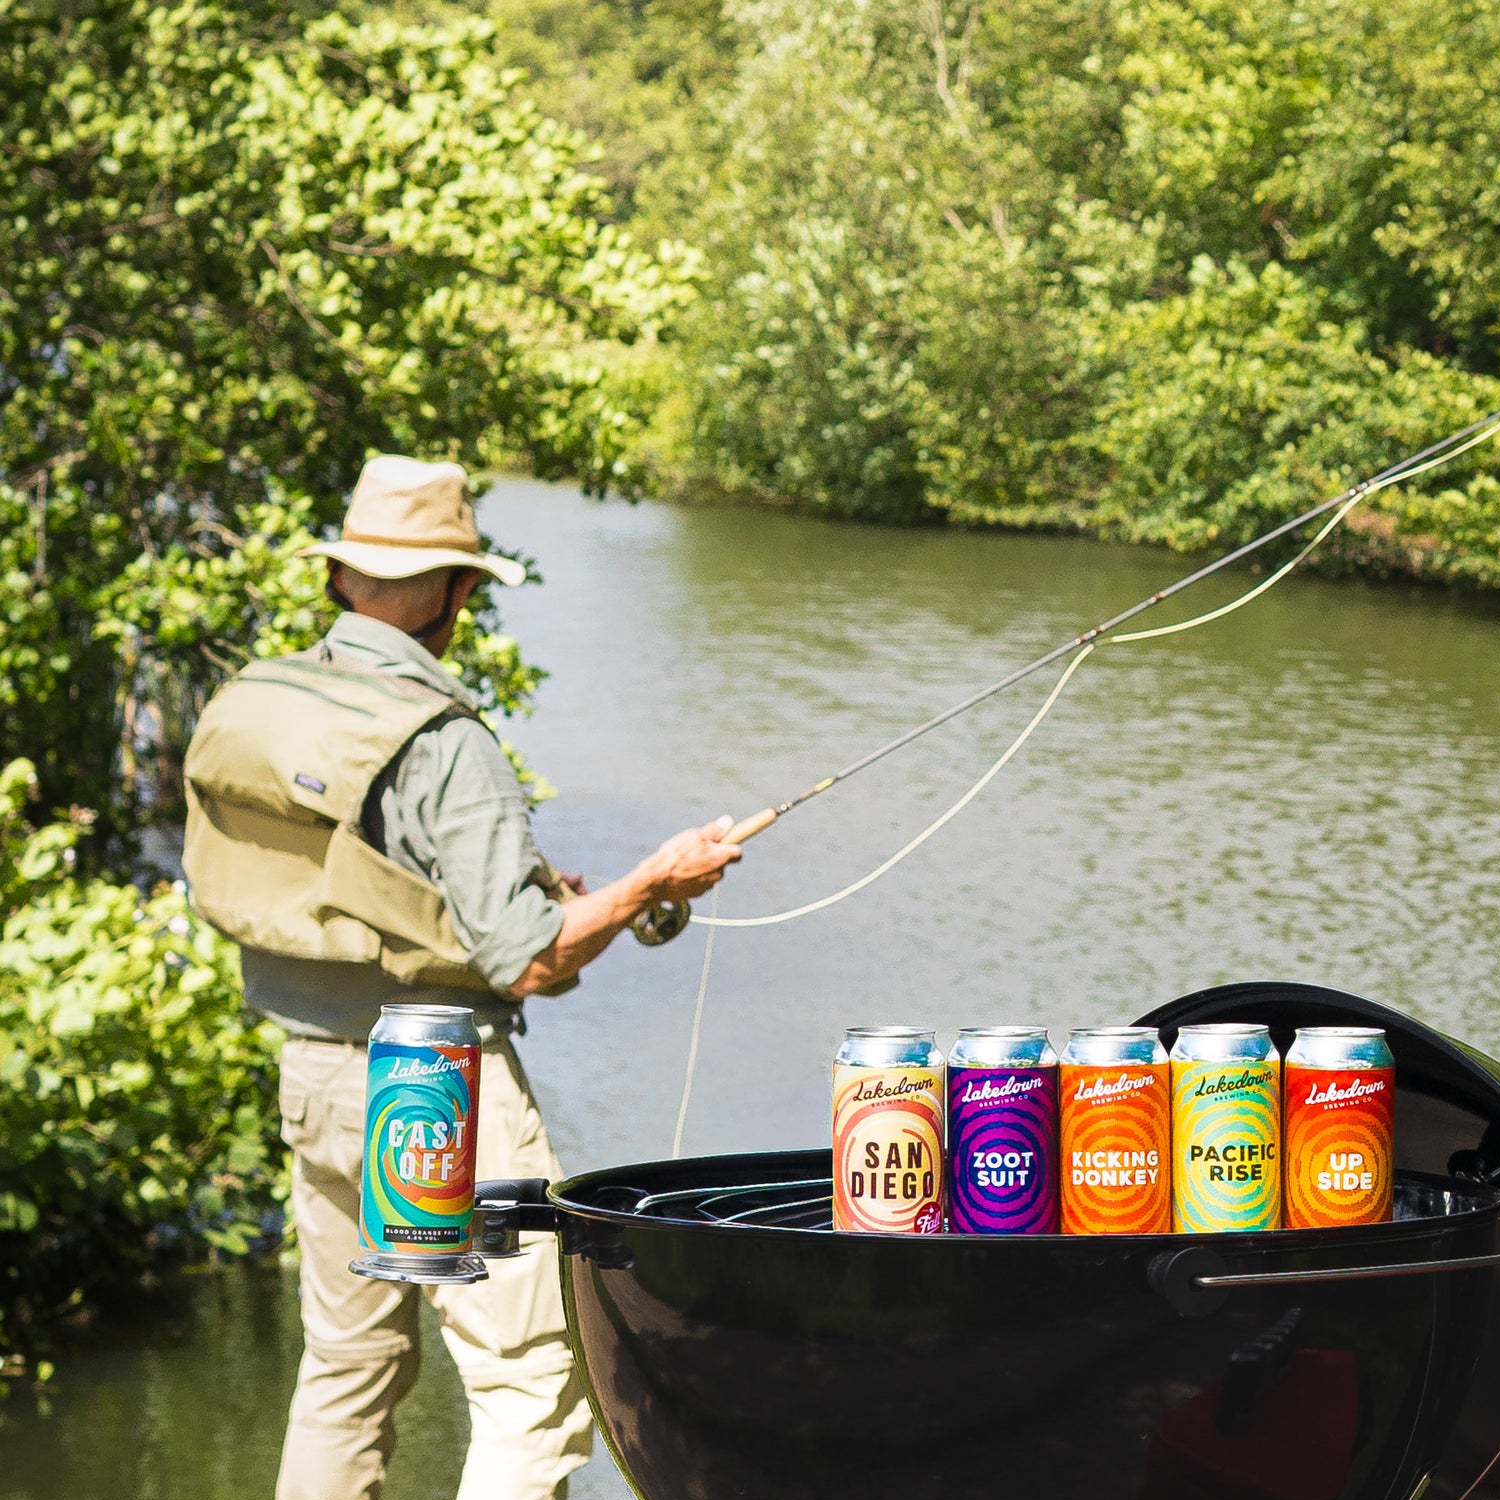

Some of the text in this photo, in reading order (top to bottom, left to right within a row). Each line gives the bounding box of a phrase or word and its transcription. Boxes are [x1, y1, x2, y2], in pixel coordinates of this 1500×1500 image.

[387, 1055, 471, 1080] Lakedown
[853, 1076, 934, 1102] Lakedown
[962, 1076, 1043, 1104] Lakedown
[1074, 1073, 1155, 1100] Lakedown
[1194, 1070, 1273, 1096] Lakedown
[1305, 1078, 1386, 1104] Lakedown
[871, 1098, 907, 1108] BREWING
[979, 1098, 1015, 1108] BREWING
[1091, 1094, 1128, 1105] BREWING
[1214, 1091, 1250, 1102] BREWING
[1324, 1100, 1360, 1110] BREWING
[388, 1119, 466, 1149] CAST
[865, 1142, 922, 1169] SAN
[973, 1152, 1034, 1168] ZOOT
[1072, 1150, 1158, 1167] KICKING
[1190, 1142, 1275, 1162] PACIFIC
[400, 1151, 454, 1181] OFF
[1330, 1153, 1363, 1172] UP
[977, 1170, 1029, 1187] SUIT
[1072, 1169, 1158, 1186] DONKEY
[1210, 1164, 1262, 1181] RISE
[1317, 1172, 1373, 1191] SIDE
[852, 1171, 934, 1199] DIEGO
